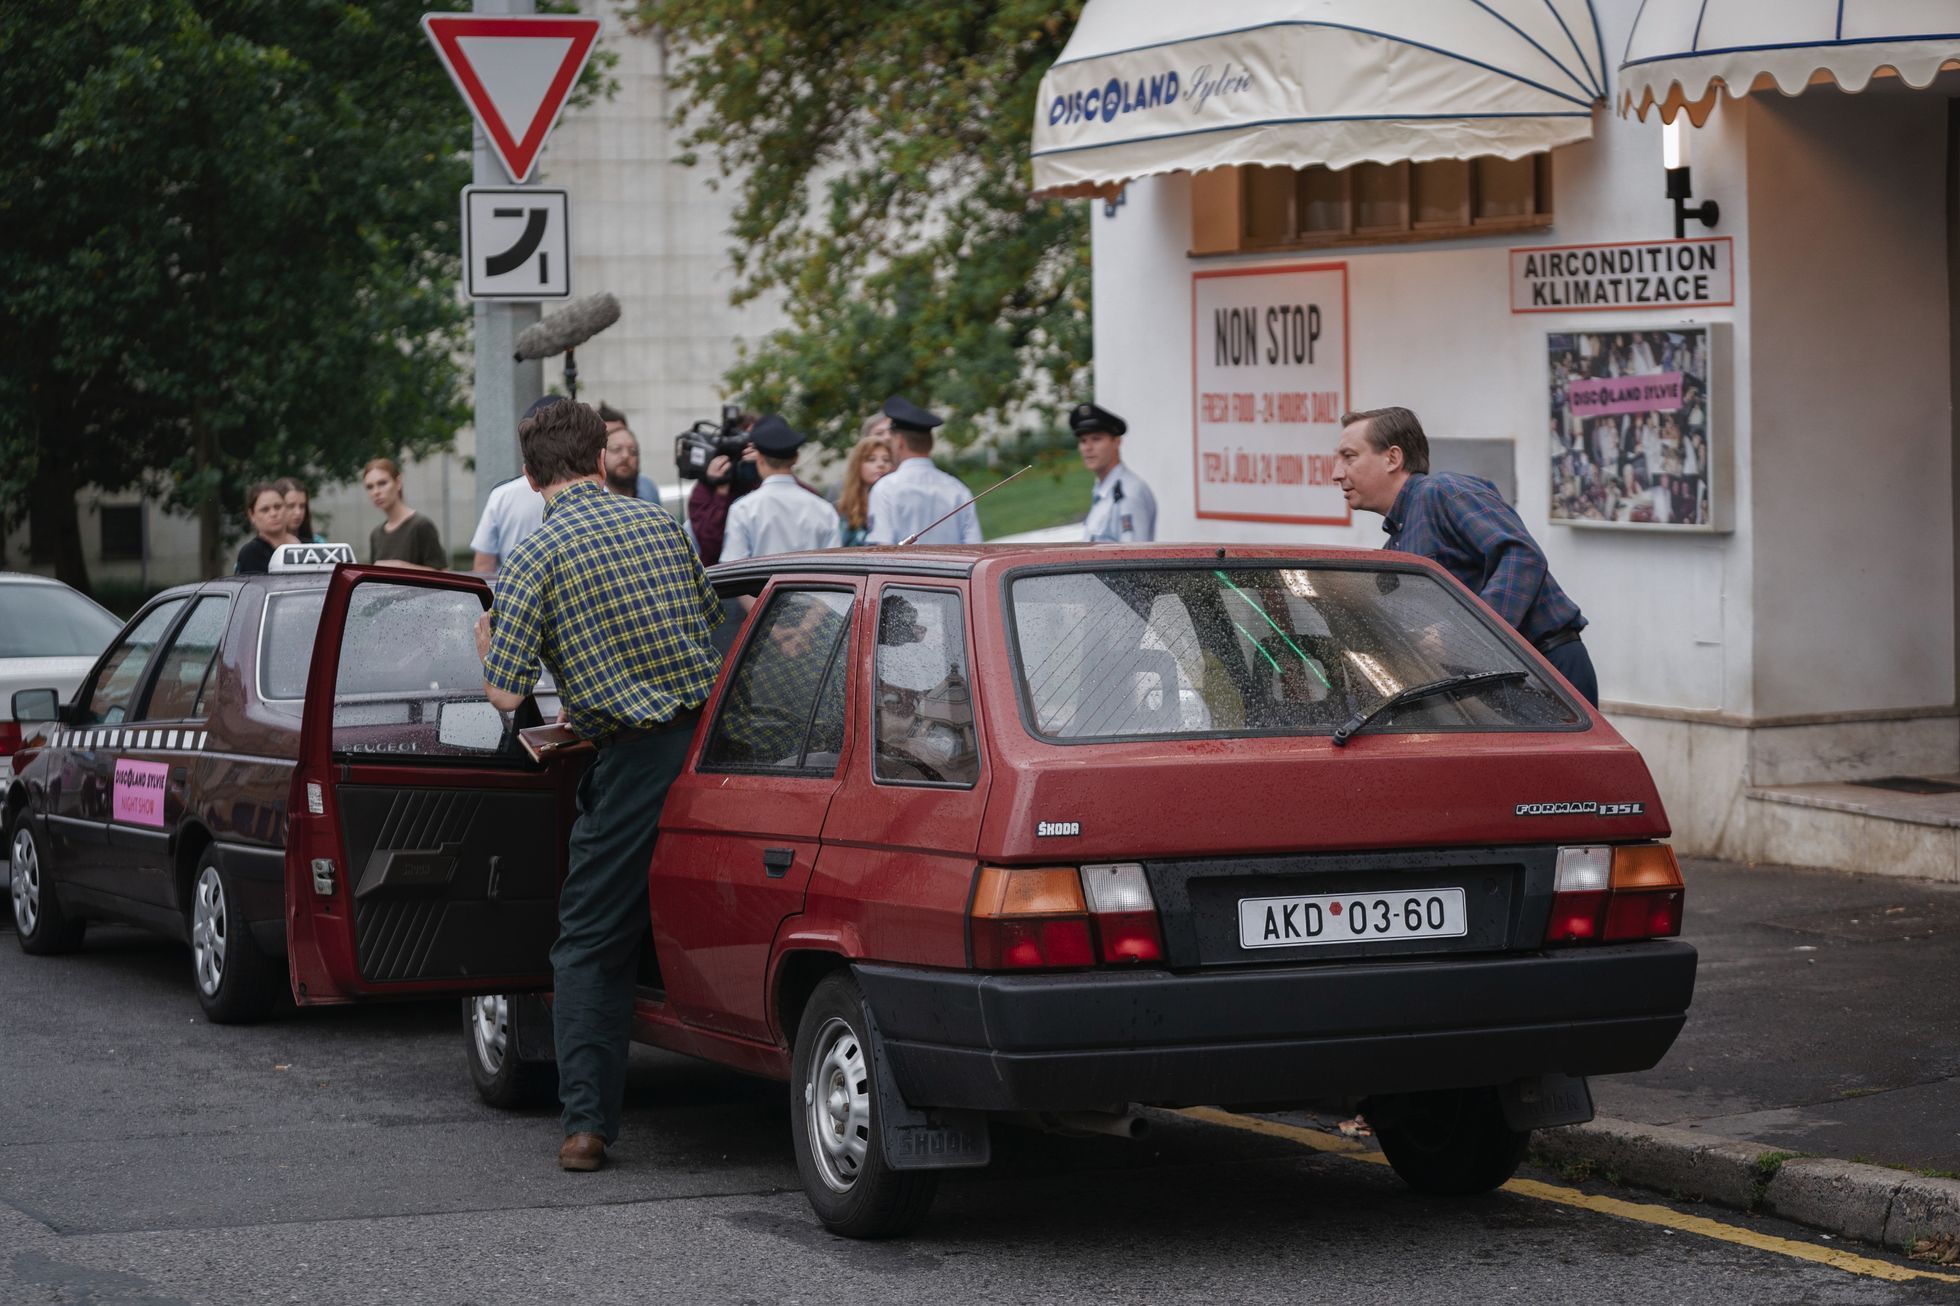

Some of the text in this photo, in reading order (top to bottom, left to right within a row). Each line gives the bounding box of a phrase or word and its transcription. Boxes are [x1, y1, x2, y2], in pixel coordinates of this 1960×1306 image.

[1049, 70, 1180, 126] DISCOLAND
[1524, 244, 1717, 278] AIRCONDITION
[1532, 275, 1709, 306] KLIMATIZACE
[1214, 303, 1322, 366] NON STOP
[1202, 392, 1229, 423] FRESH
[1232, 391, 1255, 422] FOOD
[1277, 391, 1308, 423] HOURS
[1311, 391, 1339, 423] DAILY
[1573, 383, 1678, 406] DISCOLAND SYLVIE
[286, 547, 349, 564] TAXI
[115, 768, 165, 790] DISCOLAND SYLVIE
[121, 795, 154, 816] NIGHT SHOW
[1516, 801, 1644, 815] FORMAN 135L
[1038, 821, 1079, 836] ŠKODA
[1263, 896, 1445, 940] AKD 03-60
